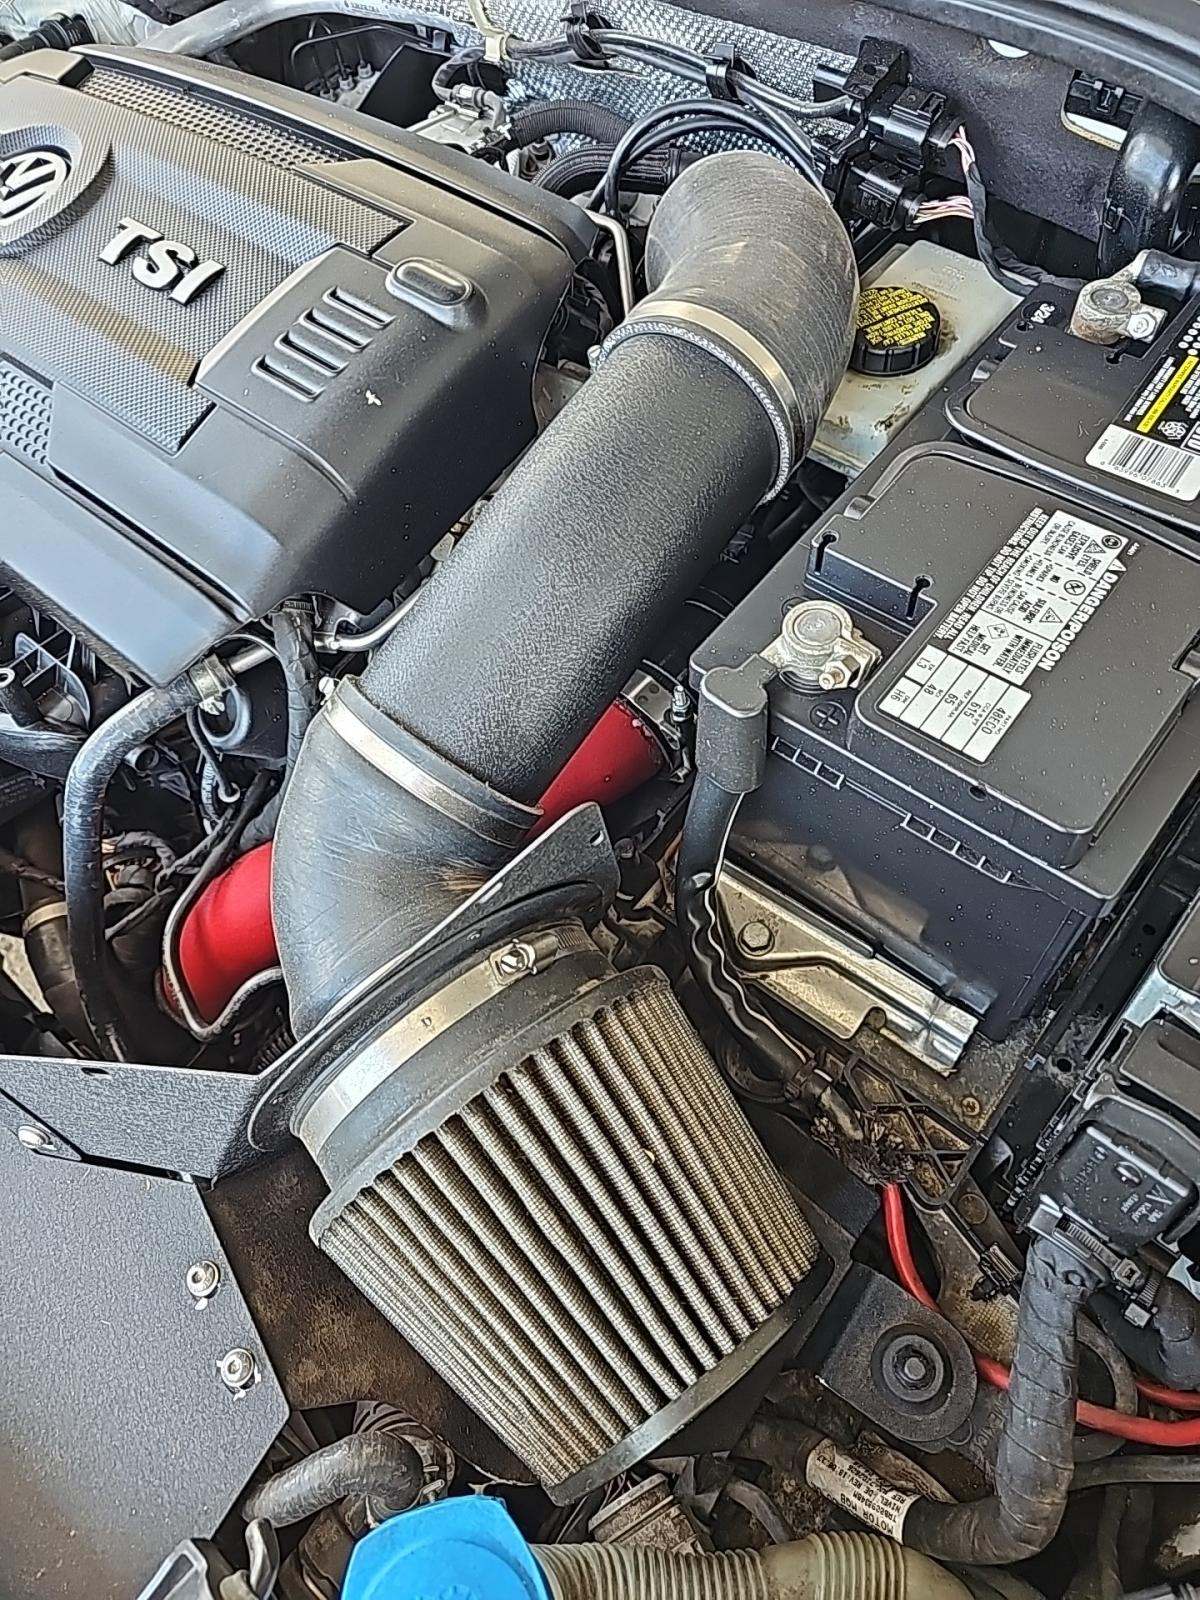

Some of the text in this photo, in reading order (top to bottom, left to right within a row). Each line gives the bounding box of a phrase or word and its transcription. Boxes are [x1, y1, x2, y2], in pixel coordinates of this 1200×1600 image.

[98, 216, 225, 306] TSI
[1037, 571, 1118, 670] DANGER/POISON
[962, 632, 986, 656] MEDICAL
[916, 656, 930, 668] L3
[1002, 637, 1033, 674] IMMEDIATELY
[1014, 658, 1030, 674] EYES
[890, 688, 905, 701] H6
[923, 683, 936, 695] 48
[944, 693, 958, 705] 65
[963, 701, 981, 718] 615
[880, 1495, 901, 1513] NIVEL
[863, 1509, 894, 1534] MOTOR
